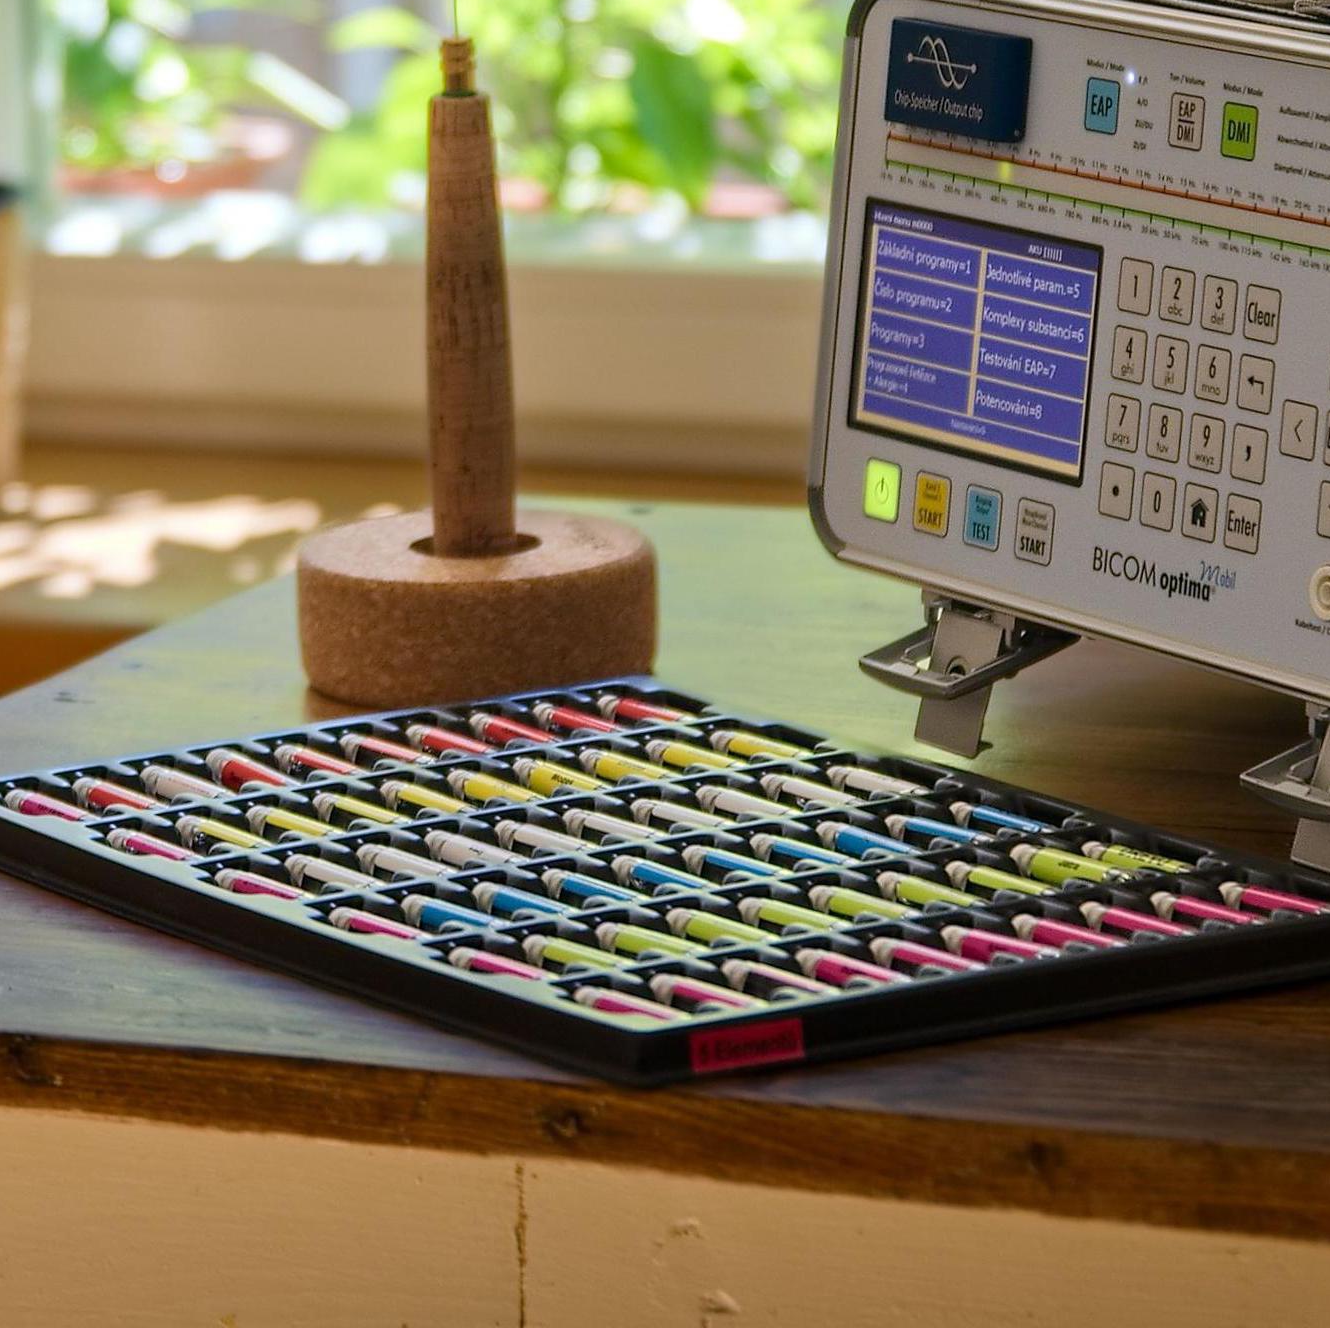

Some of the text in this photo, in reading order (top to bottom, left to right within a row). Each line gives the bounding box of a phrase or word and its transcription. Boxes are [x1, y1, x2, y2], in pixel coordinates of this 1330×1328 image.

[894, 89, 938, 112] Chip-Speicher
[944, 98, 967, 117] Output
[969, 104, 983, 122] chip
[1091, 94, 1113, 117] EAP
[1178, 100, 1196, 118] EAP
[1177, 125, 1195, 143] DMI
[1227, 120, 1250, 144] DMI
[877, 239, 971, 273] Základní programy=1
[986, 263, 1080, 299] Jednotlivé param.=5
[1134, 275, 1138, 298] 1
[1174, 277, 1182, 301] 2
[896, 285, 953, 312] programu=2
[1215, 287, 1224, 310] 3
[983, 307, 1026, 332] Komplexy
[1167, 305, 1183, 318] abc
[1211, 314, 1225, 325] def
[1247, 302, 1276, 328] Clear
[871, 322, 925, 348] Programy=3
[1126, 337, 1133, 359] 4
[1166, 346, 1175, 369] 5
[979, 347, 1057, 379] Testování EAP=7
[1121, 363, 1135, 377] ghi
[1209, 356, 1216, 379] 6
[1201, 384, 1221, 396] mno
[976, 389, 1043, 421] Potencování=8
[1119, 404, 1128, 427] 7
[1160, 415, 1169, 438] 8
[1203, 424, 1211, 448] 9
[1153, 490, 1161, 513] 0
[918, 508, 942, 529] START
[1227, 510, 1257, 538] Enter
[972, 522, 991, 542] TEST
[1020, 536, 1046, 558] START
[1092, 546, 1157, 587] BICOM
[1160, 572, 1211, 602] optima
